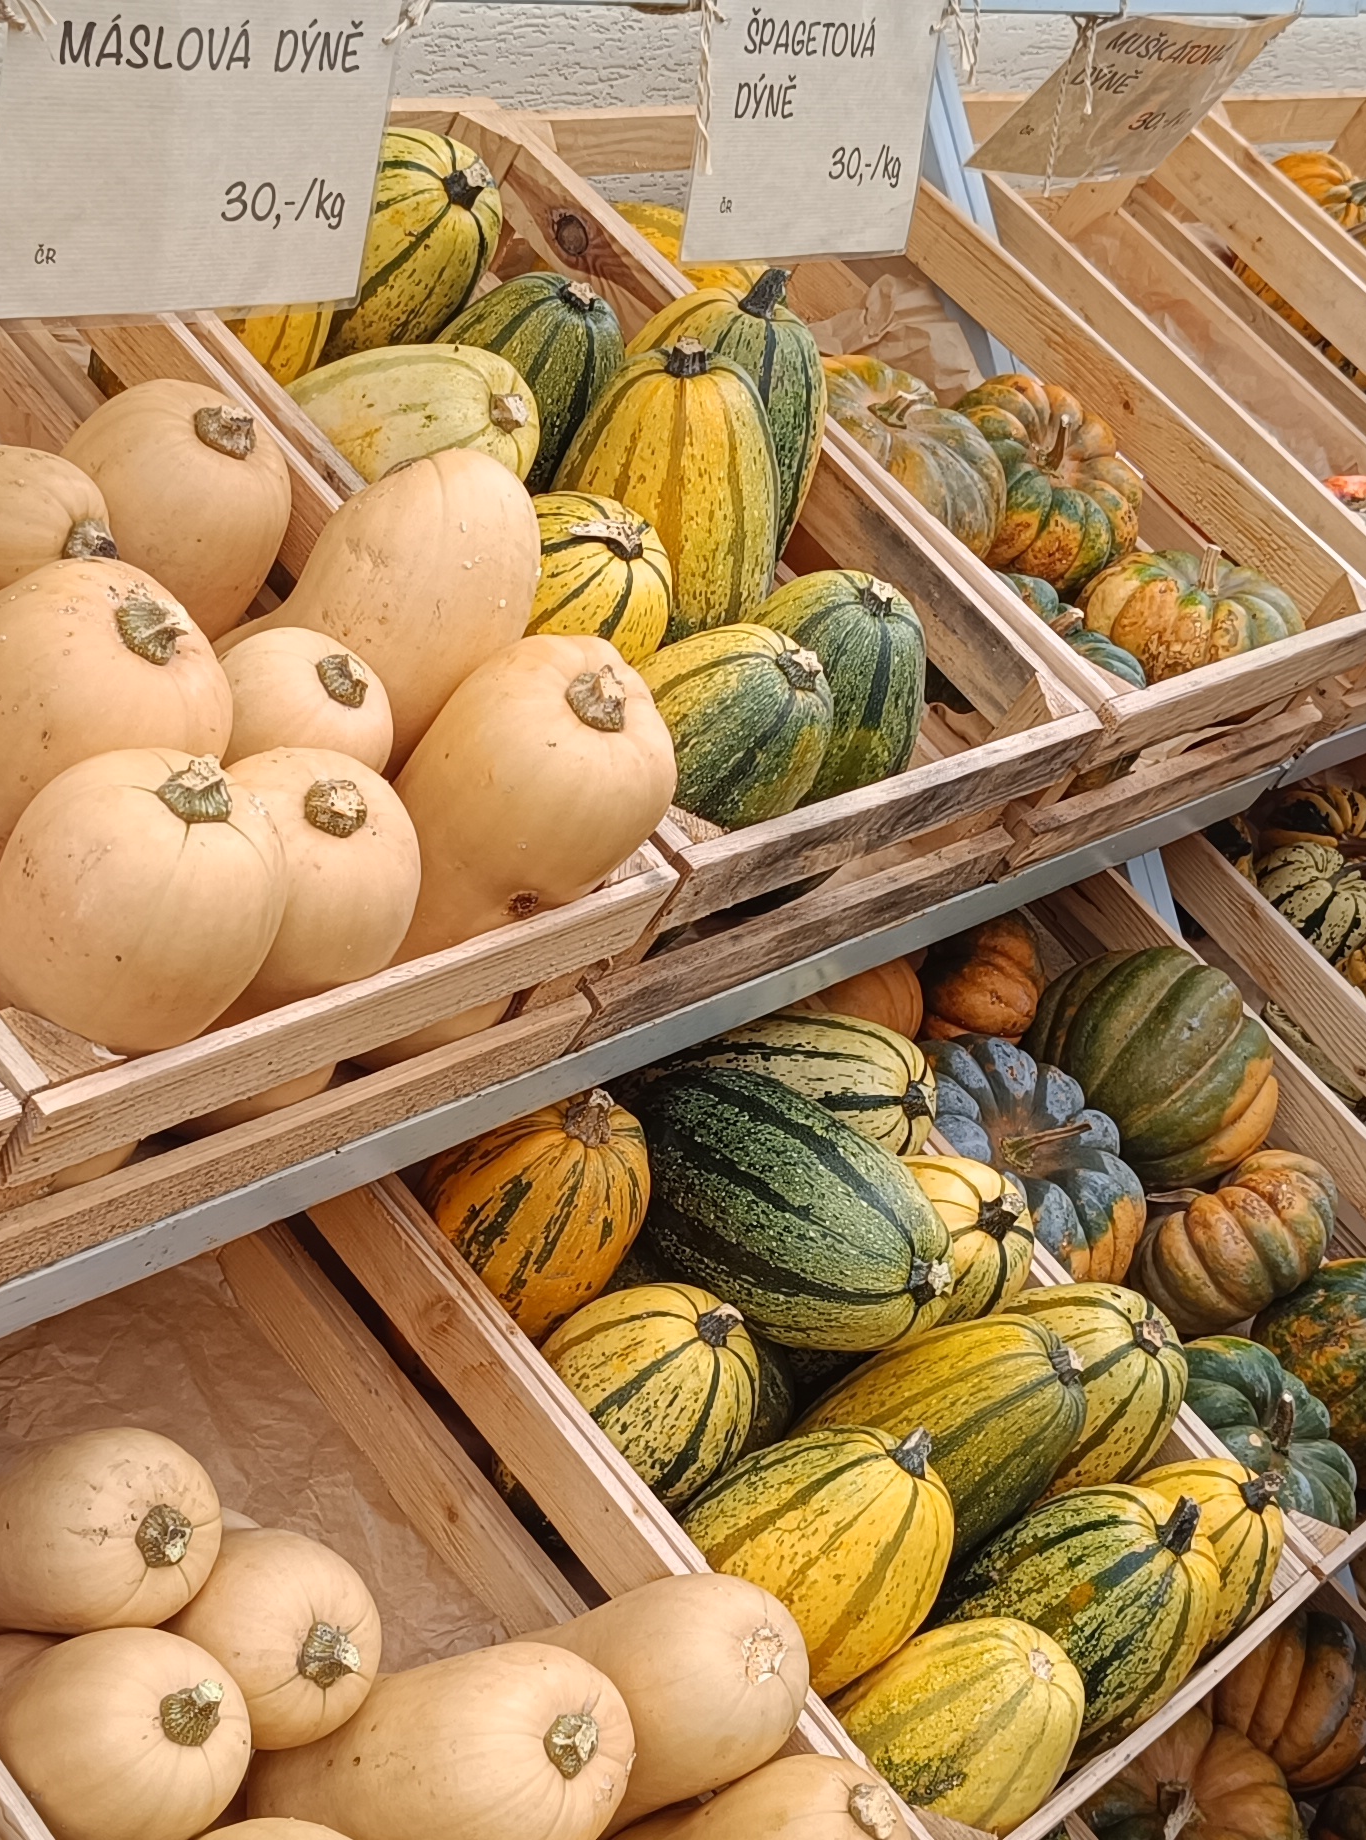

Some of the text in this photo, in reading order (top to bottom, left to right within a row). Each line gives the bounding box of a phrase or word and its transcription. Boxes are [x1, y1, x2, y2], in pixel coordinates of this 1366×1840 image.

[59, 14, 364, 73] MÁSLOVÁ DÝNĚ
[744, 7, 877, 58] ŠPAGETOVÁ
[734, 73, 797, 120] DÝNĚ
[1070, 63, 1144, 94] DÝNĚ
[828, 144, 901, 188] 30,-/kg
[221, 178, 346, 230] 30,-/kg
[719, 196, 733, 214] ČR
[34, 244, 56, 265] ČR
